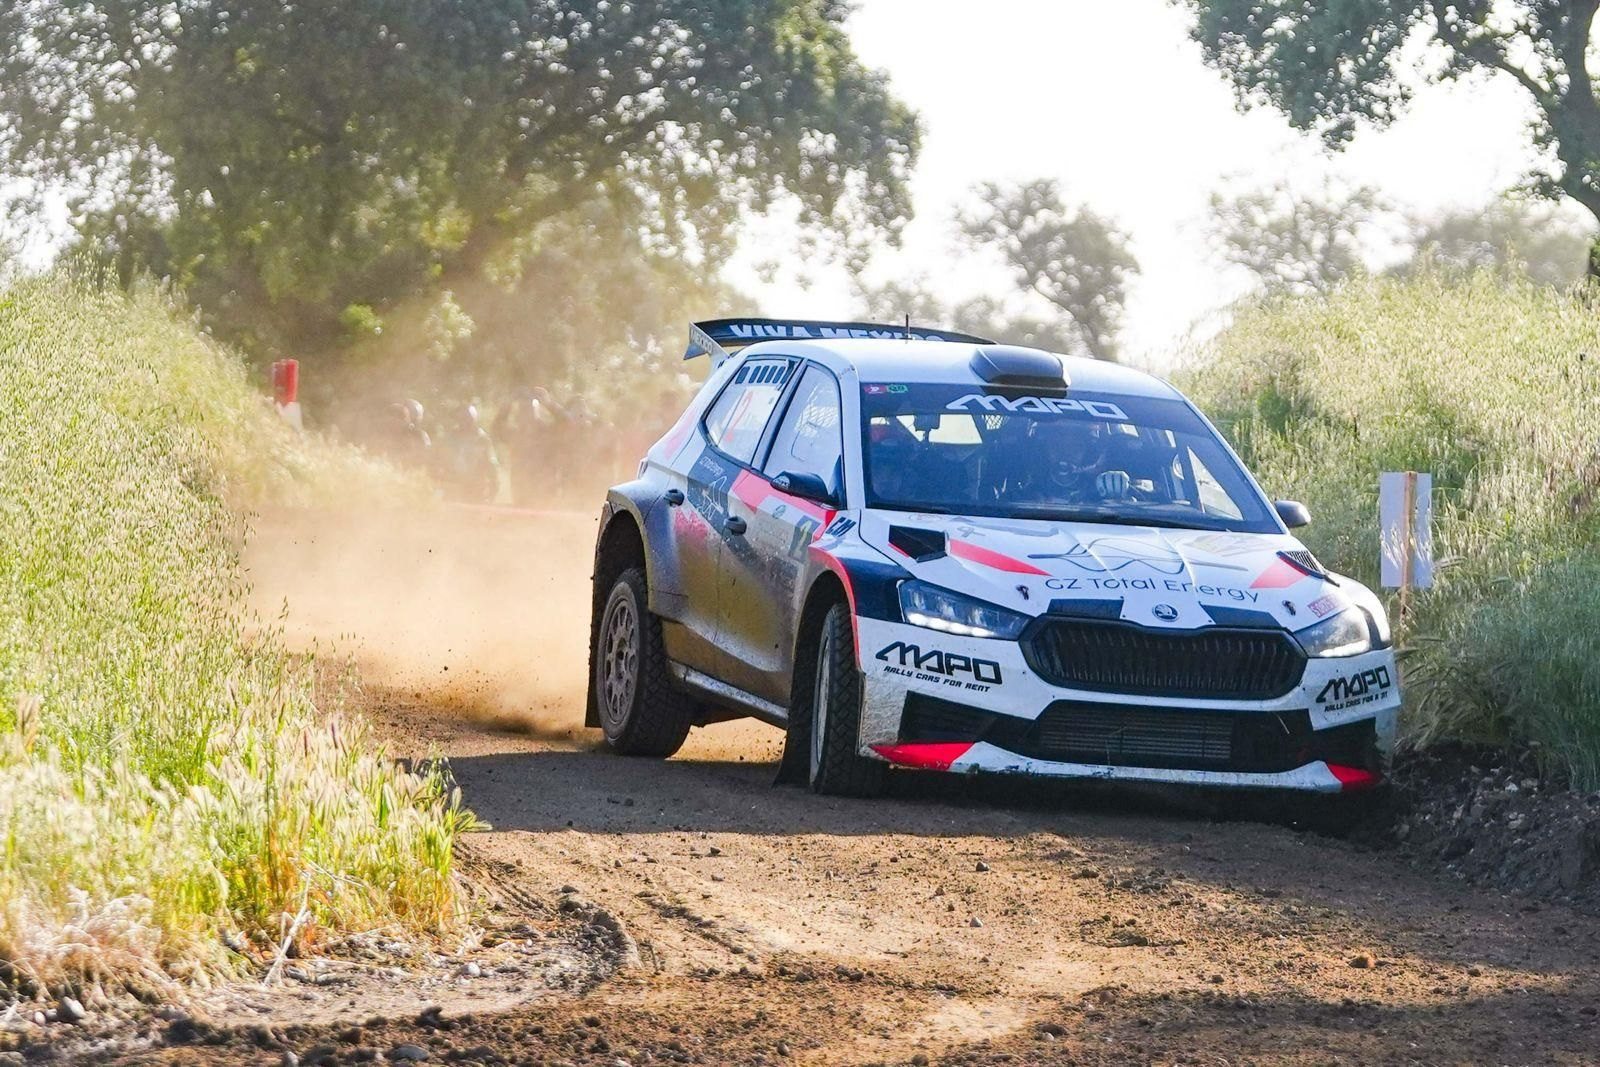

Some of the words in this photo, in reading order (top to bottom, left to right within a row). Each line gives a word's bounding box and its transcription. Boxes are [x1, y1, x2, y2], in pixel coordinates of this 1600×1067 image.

[729, 324, 813, 337] VIVA
[946, 394, 1129, 420] MAPO
[1045, 578, 1082, 590] GZ
[1087, 578, 1155, 590] Total
[1164, 579, 1259, 603] Energy
[875, 641, 1003, 685] MAPO
[883, 665, 913, 677] RALLY
[915, 672, 940, 683] CARS
[943, 678, 963, 688] FOR
[964, 681, 991, 693] RENT
[1315, 665, 1391, 703] MAPO
